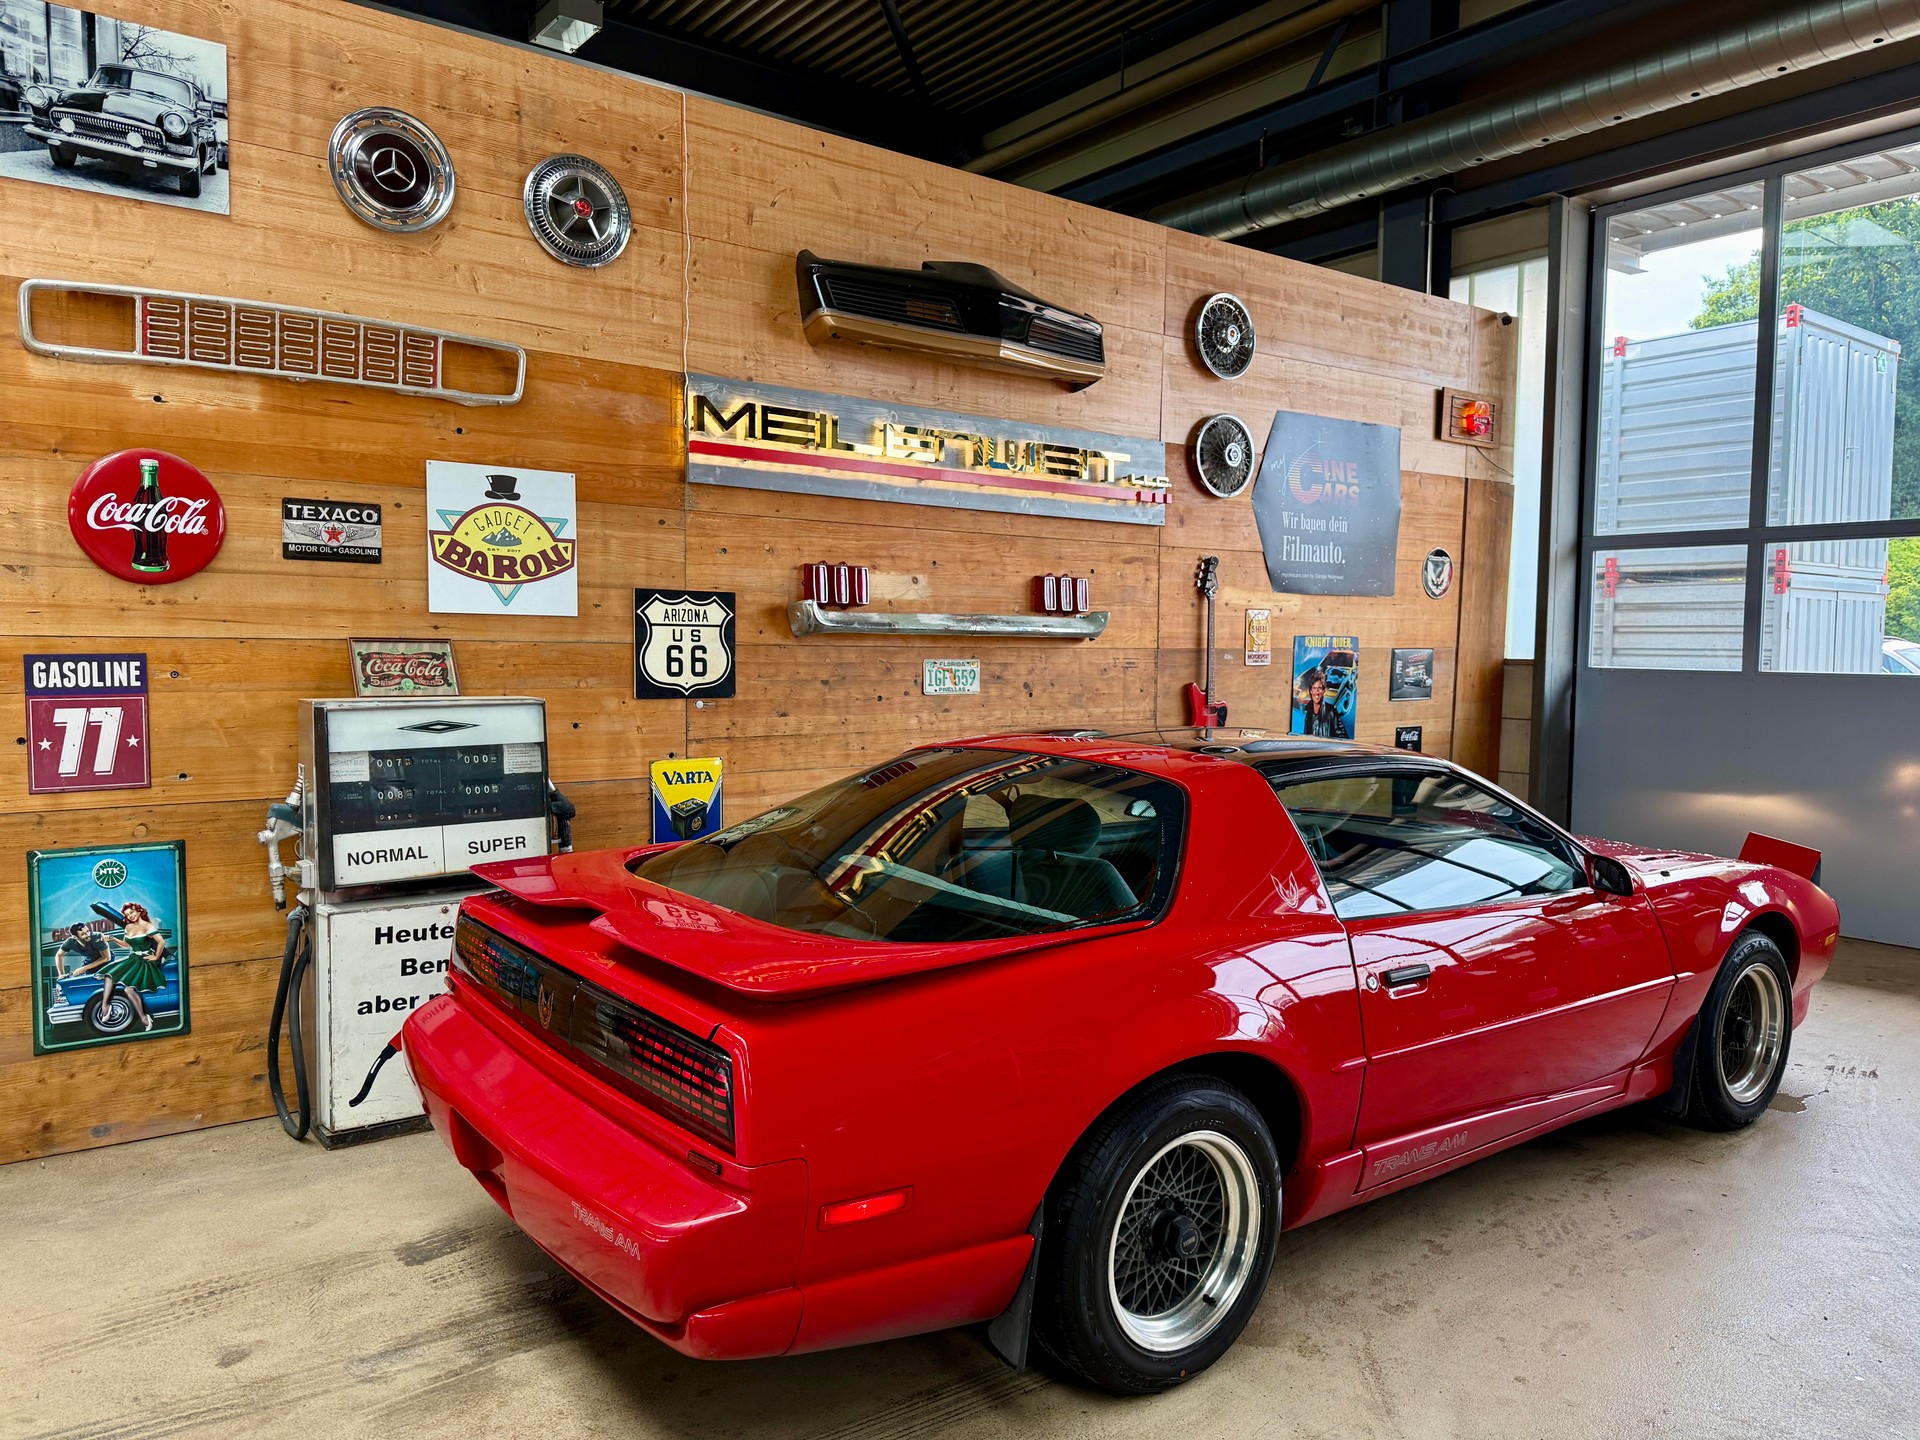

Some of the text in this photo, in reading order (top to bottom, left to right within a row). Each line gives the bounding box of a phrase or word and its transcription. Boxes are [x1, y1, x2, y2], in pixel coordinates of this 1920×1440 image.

[86, 492, 210, 535] Coca-Cola
[286, 503, 379, 524] TEXACO
[473, 510, 534, 535] GADGET
[1281, 511, 1348, 533] Wir bauen dein
[288, 544, 318, 553] MOTOR
[439, 537, 570, 580] BARON
[1281, 535, 1346, 564] Filmauto.
[663, 607, 709, 623] ARIZONA
[1251, 625, 1268, 634] SHELL
[1304, 636, 1330, 648] KNIGHT
[366, 658, 443, 677] Coca-Cola
[666, 644, 708, 677] 66
[32, 661, 142, 689] GASOLINE
[53, 706, 124, 777] 77
[662, 771, 714, 785] VARTA
[347, 845, 429, 867] NORMAL
[467, 835, 527, 855] SUPER
[100, 867, 121, 875] NTK
[375, 922, 455, 945] Heute
[357, 995, 420, 1017] aber
[1373, 1130, 1468, 1176] TRANS AM
[571, 1200, 641, 1261] TRANS AM
